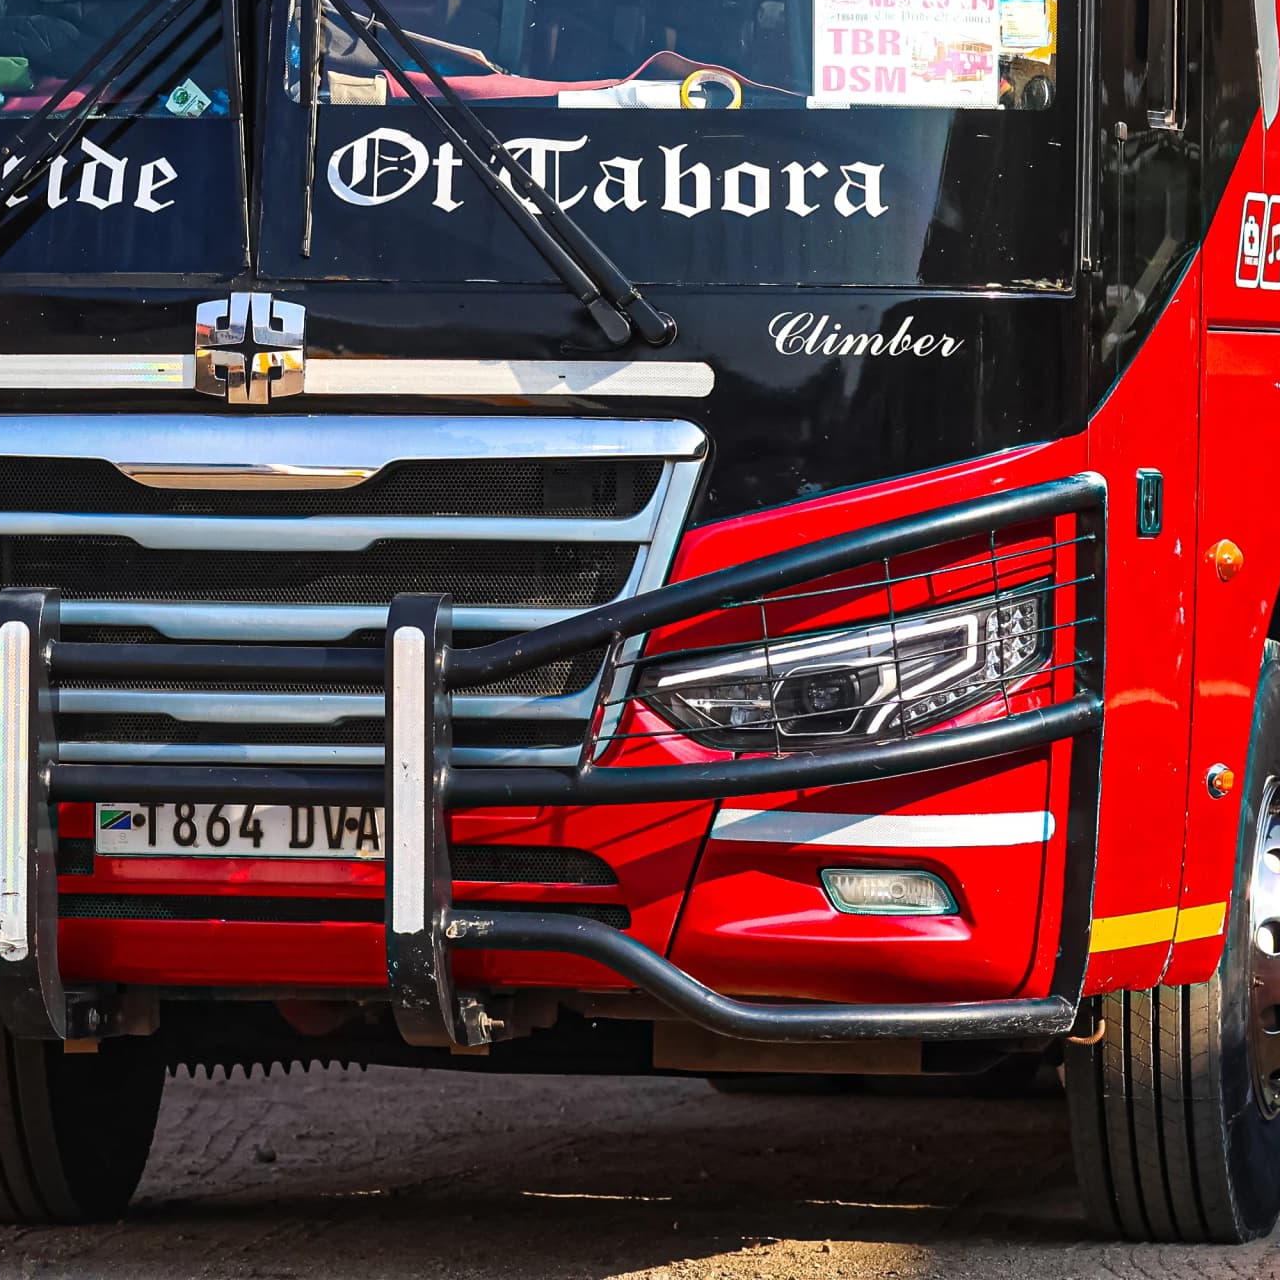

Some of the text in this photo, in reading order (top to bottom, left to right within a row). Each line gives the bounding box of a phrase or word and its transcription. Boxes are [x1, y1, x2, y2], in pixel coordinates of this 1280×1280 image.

[827, 28, 901, 56] TBR
[822, 65, 907, 94] DSM
[489, 134, 890, 219] Tabora
[768, 311, 965, 357] Climber
[140, 803, 380, 851] T 864 DVA
